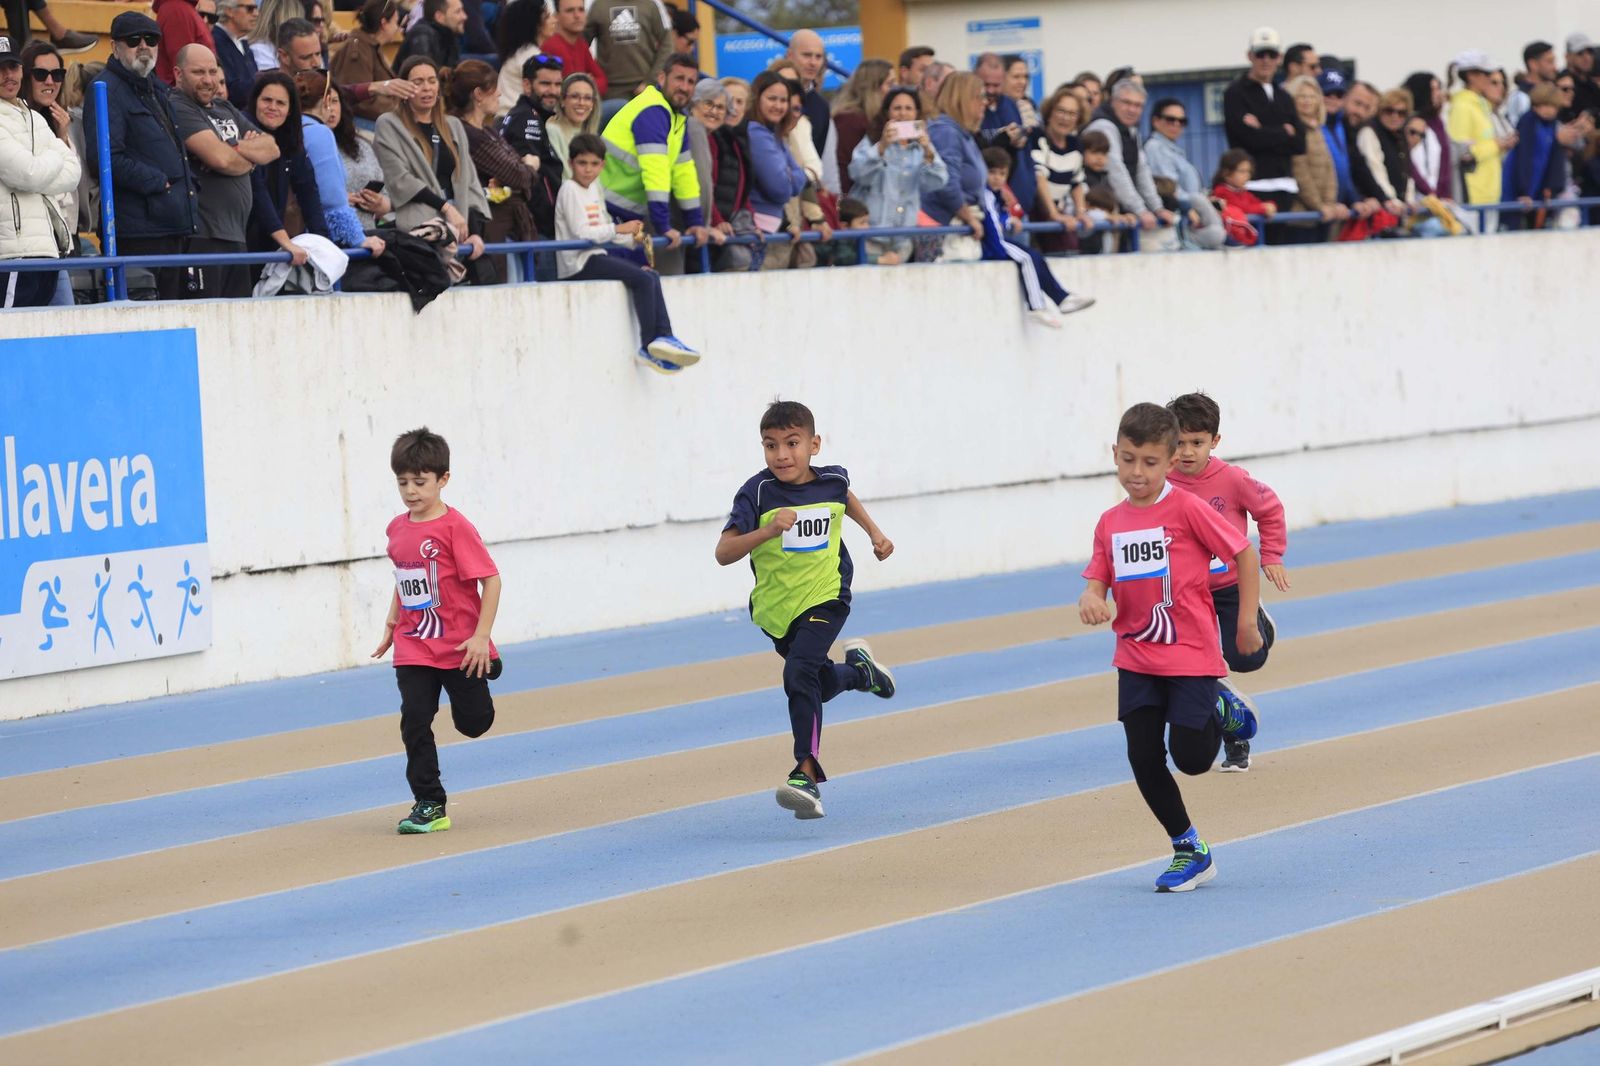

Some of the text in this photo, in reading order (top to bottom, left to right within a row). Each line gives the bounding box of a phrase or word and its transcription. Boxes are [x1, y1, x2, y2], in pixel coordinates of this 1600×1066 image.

[0, 436, 157, 540] lavera
[795, 518, 830, 537] 1007
[1121, 540, 1164, 564] 1095
[400, 578, 428, 596] 1081
